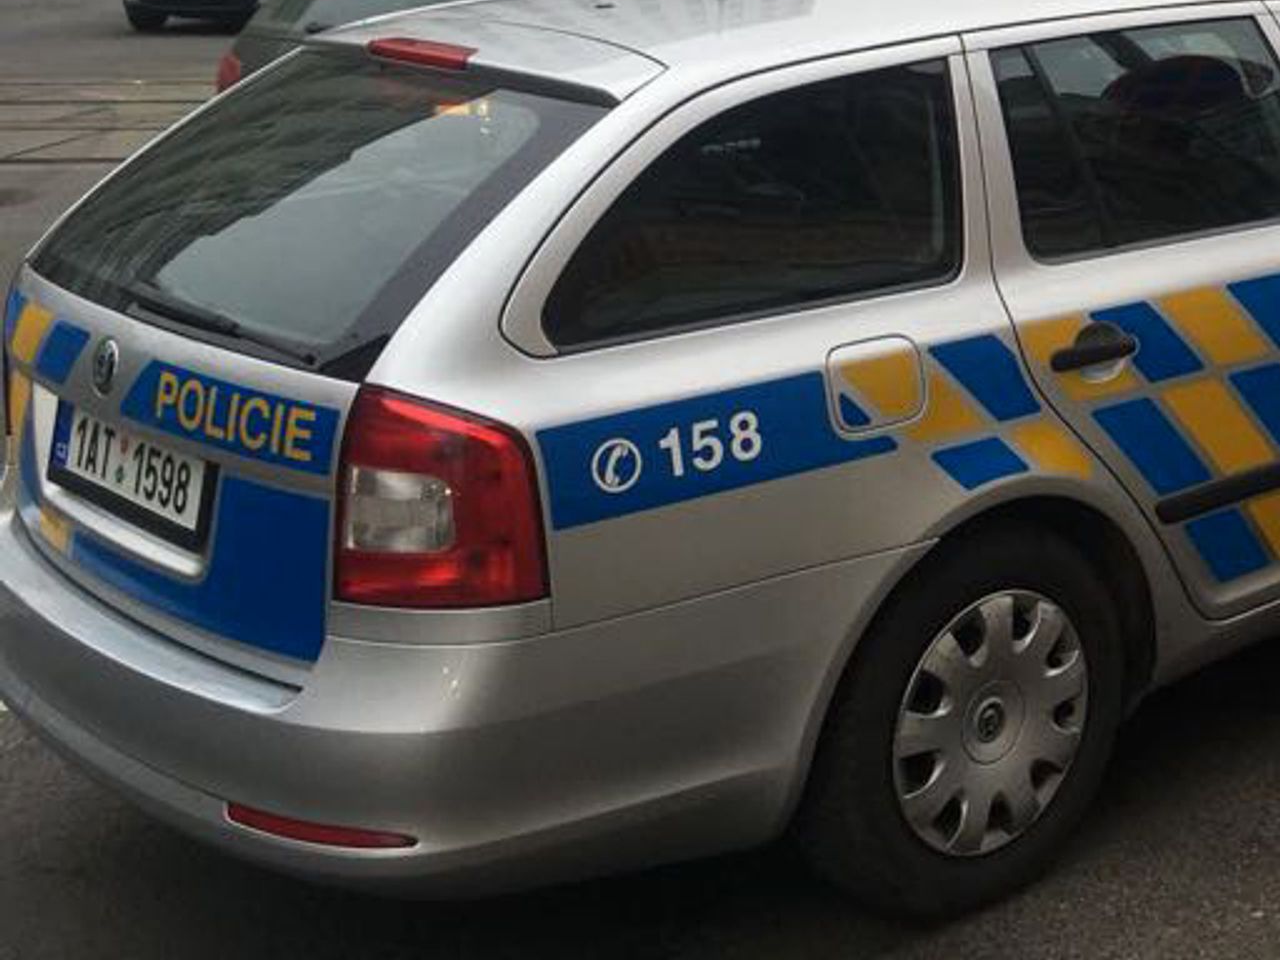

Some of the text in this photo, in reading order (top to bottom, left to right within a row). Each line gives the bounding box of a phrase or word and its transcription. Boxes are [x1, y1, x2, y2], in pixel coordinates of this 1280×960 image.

[154, 371, 316, 461] POLICIE
[659, 411, 762, 477] 158
[76, 416, 192, 515] 1AT 1598
